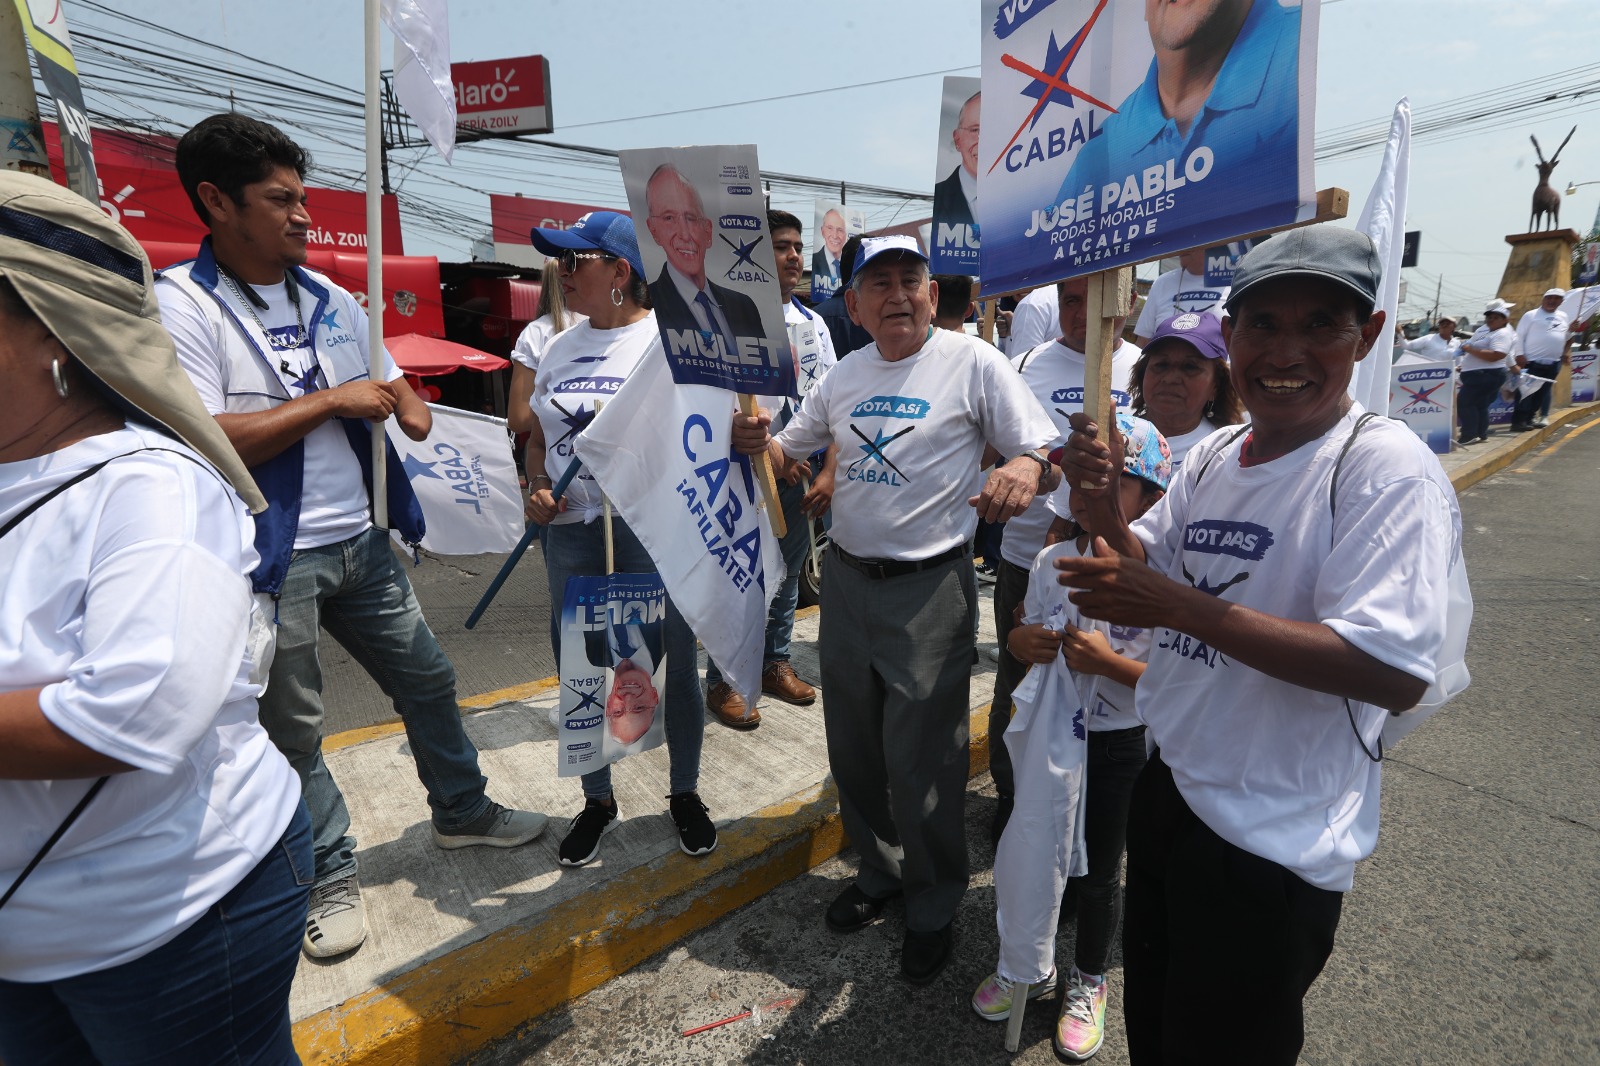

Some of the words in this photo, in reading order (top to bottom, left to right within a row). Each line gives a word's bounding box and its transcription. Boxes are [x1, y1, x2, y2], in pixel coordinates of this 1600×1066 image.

[490, 115, 519, 128] ZOILY
[1005, 109, 1104, 173] CABAL
[1024, 184, 1095, 238] JOSÉ
[1101, 146, 1214, 214] PABLO
[720, 218, 742, 227] VOTA
[1050, 221, 1096, 246] RODAS
[1100, 193, 1176, 230] MORALES
[1054, 218, 1158, 261] ALCALDE
[1073, 242, 1131, 266] MAZATE
[728, 270, 770, 283] CABAL
[326, 334, 356, 348] CABAL
[666, 328, 784, 368] MULET
[678, 358, 740, 374] PRESIDENTE
[742, 367, 780, 379] 2024
[1401, 373, 1428, 381] VOTA
[560, 381, 597, 391] VOTA
[1402, 406, 1442, 415] CABAL
[847, 467, 901, 487] CABAL
[675, 478, 753, 594] ¡AFILIATE!
[567, 596, 666, 632] MULET
[569, 674, 605, 688] CABAL
[583, 716, 603, 727] VOTA
